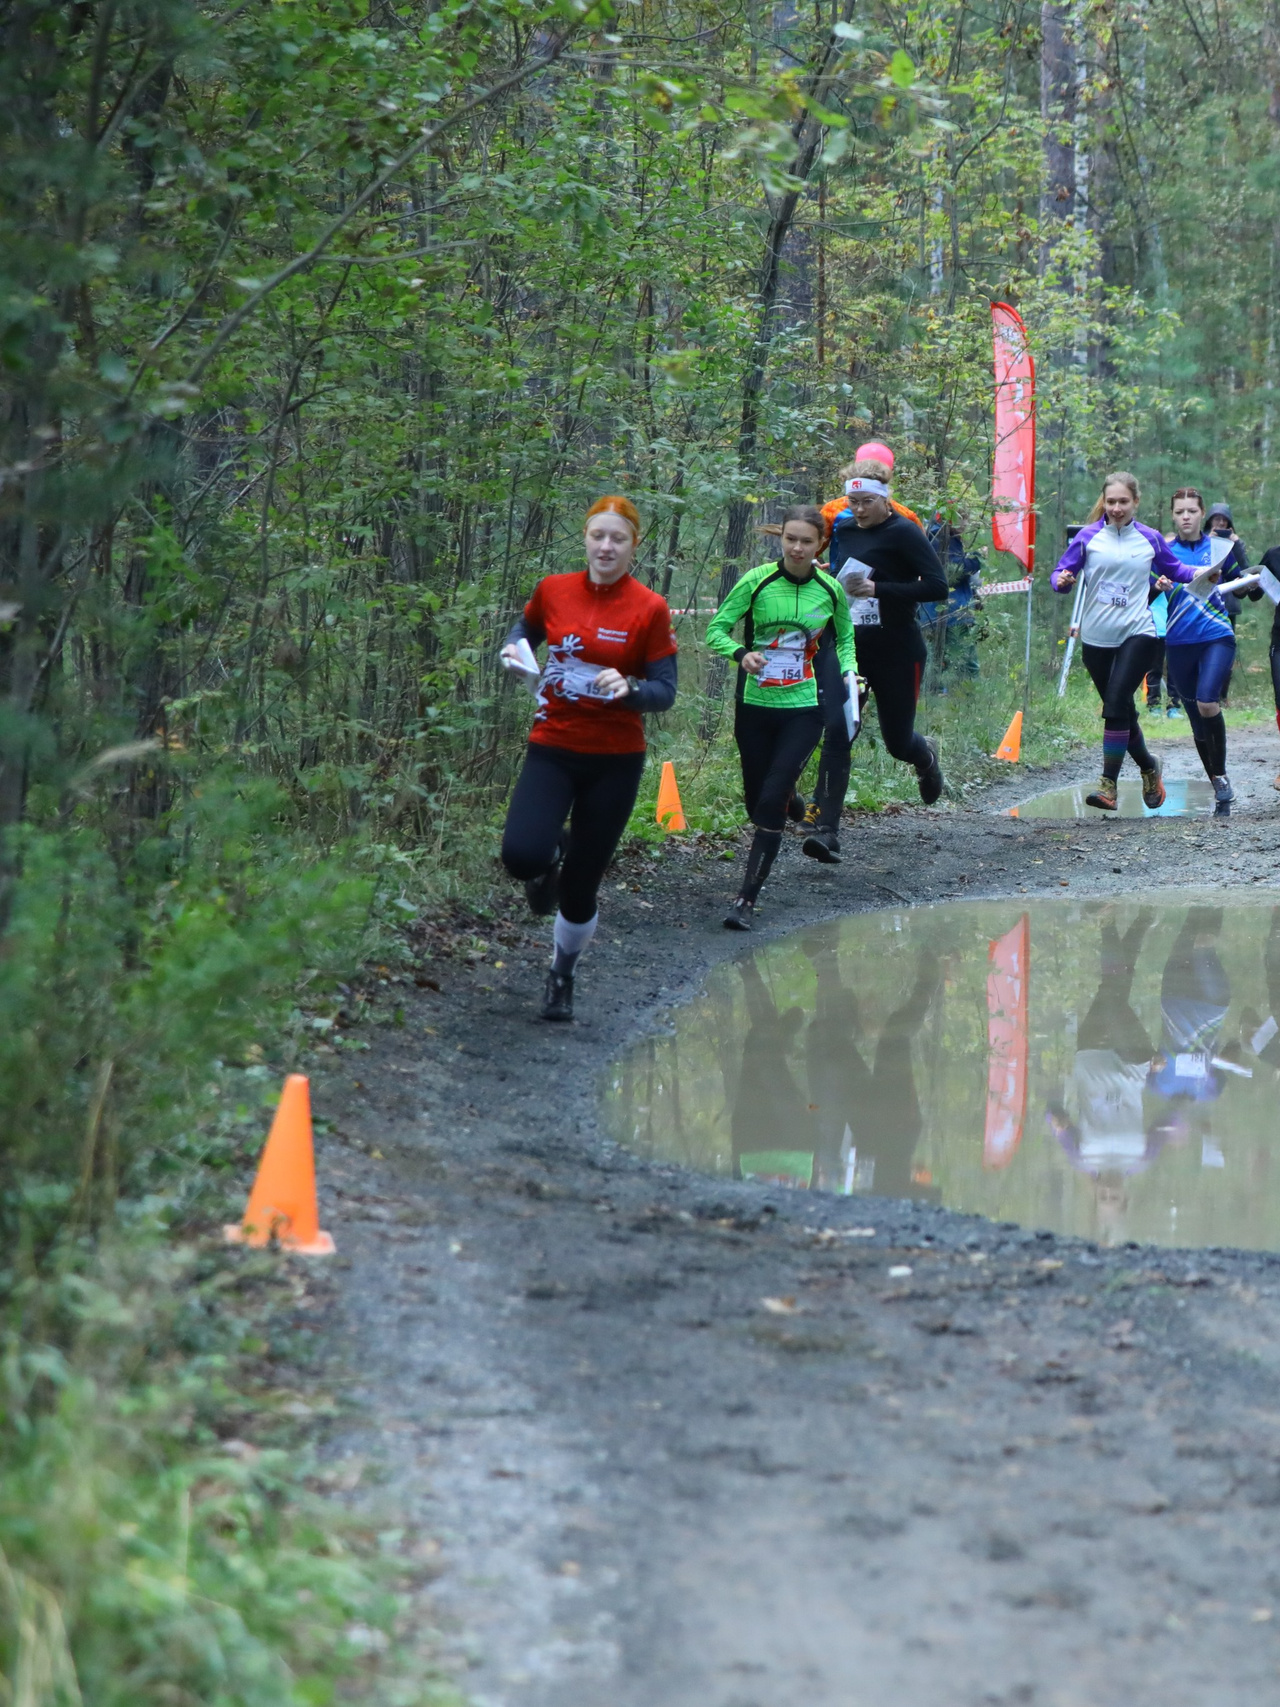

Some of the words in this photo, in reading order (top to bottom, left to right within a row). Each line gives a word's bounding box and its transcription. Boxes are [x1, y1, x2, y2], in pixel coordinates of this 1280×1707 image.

[1111, 597, 1127, 606] 158
[860, 614, 878, 624] 159
[781, 669, 801, 680] 154
